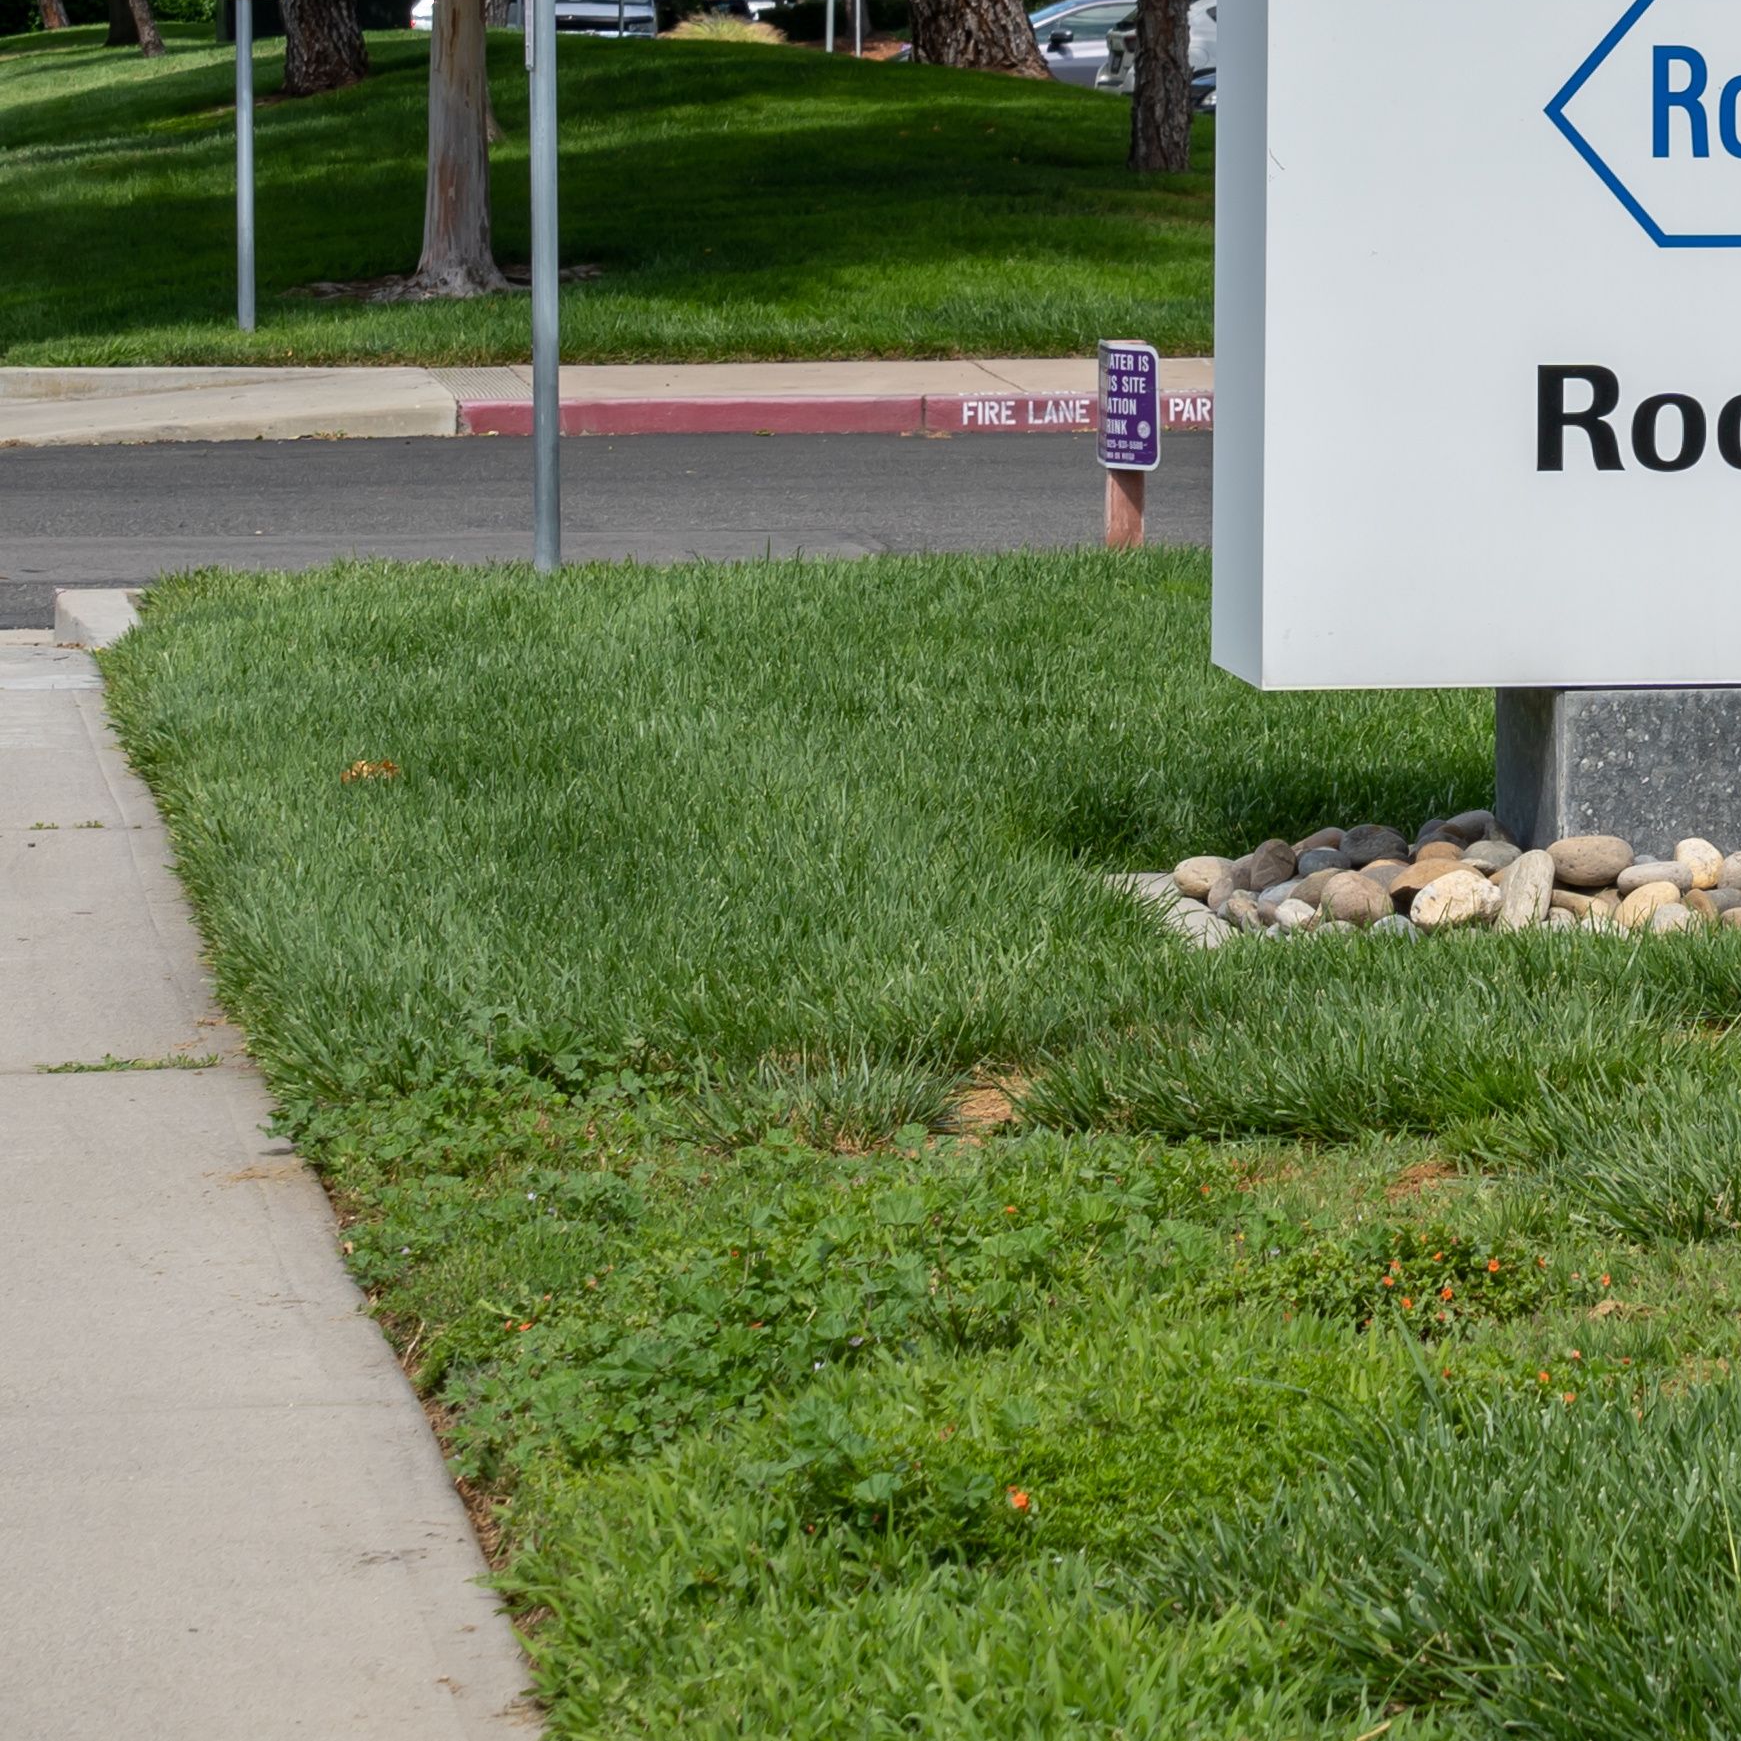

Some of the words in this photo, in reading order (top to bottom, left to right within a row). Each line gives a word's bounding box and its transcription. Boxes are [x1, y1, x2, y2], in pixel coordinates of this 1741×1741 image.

[1108, 353, 1134, 371] ATER
[1138, 355, 1150, 372] IS
[1121, 376, 1147, 394] SITE
[962, 401, 1016, 425] FIRE
[1028, 399, 1090, 424] LANE
[1168, 397, 1212, 422] PAR
[1107, 397, 1137, 415] ATION
[1106, 419, 1128, 436] RINK
